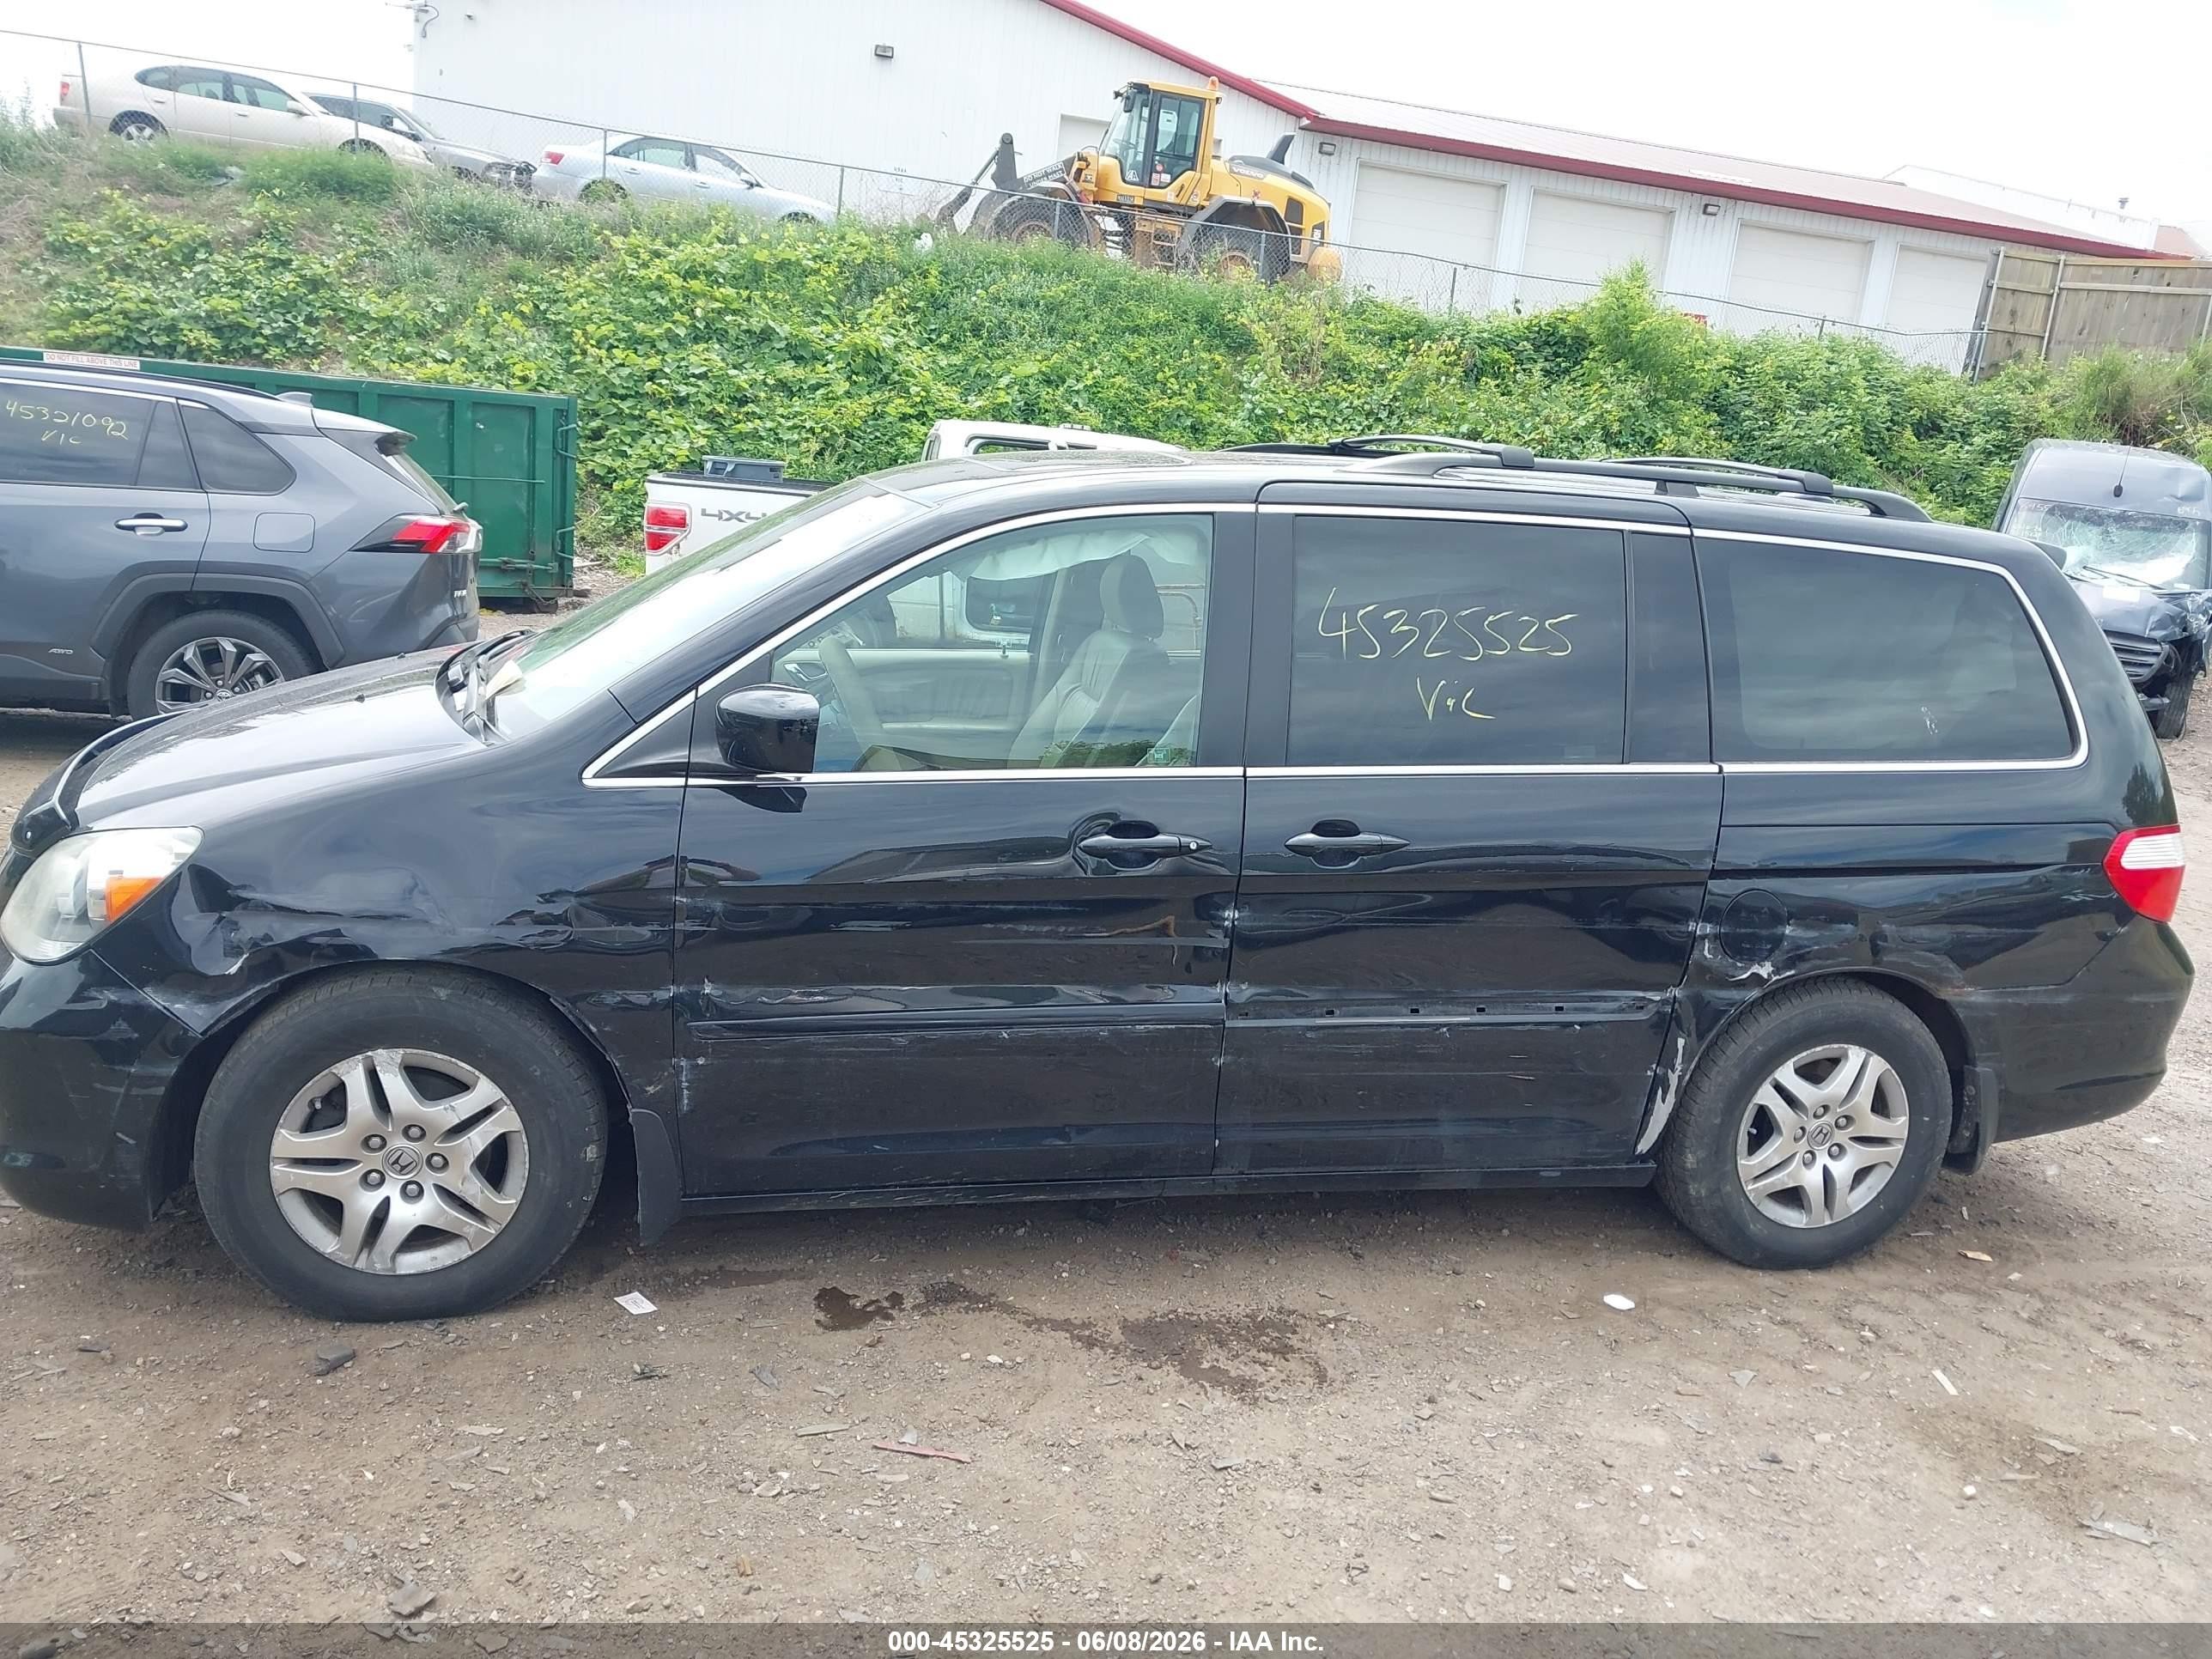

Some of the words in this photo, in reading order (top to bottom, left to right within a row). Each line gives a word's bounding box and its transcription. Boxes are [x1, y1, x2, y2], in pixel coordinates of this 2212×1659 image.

[1033, 171, 1045, 179] NOT
[1047, 162, 1064, 173] WALK
[1048, 171, 1064, 180] MAST
[1232, 167, 1264, 178] VOLVO
[87, 357, 107, 366] ABOVE
[124, 360, 138, 368] LINE
[6, 399, 129, 440] 45321092
[1318, 586, 1579, 661] 45325525
